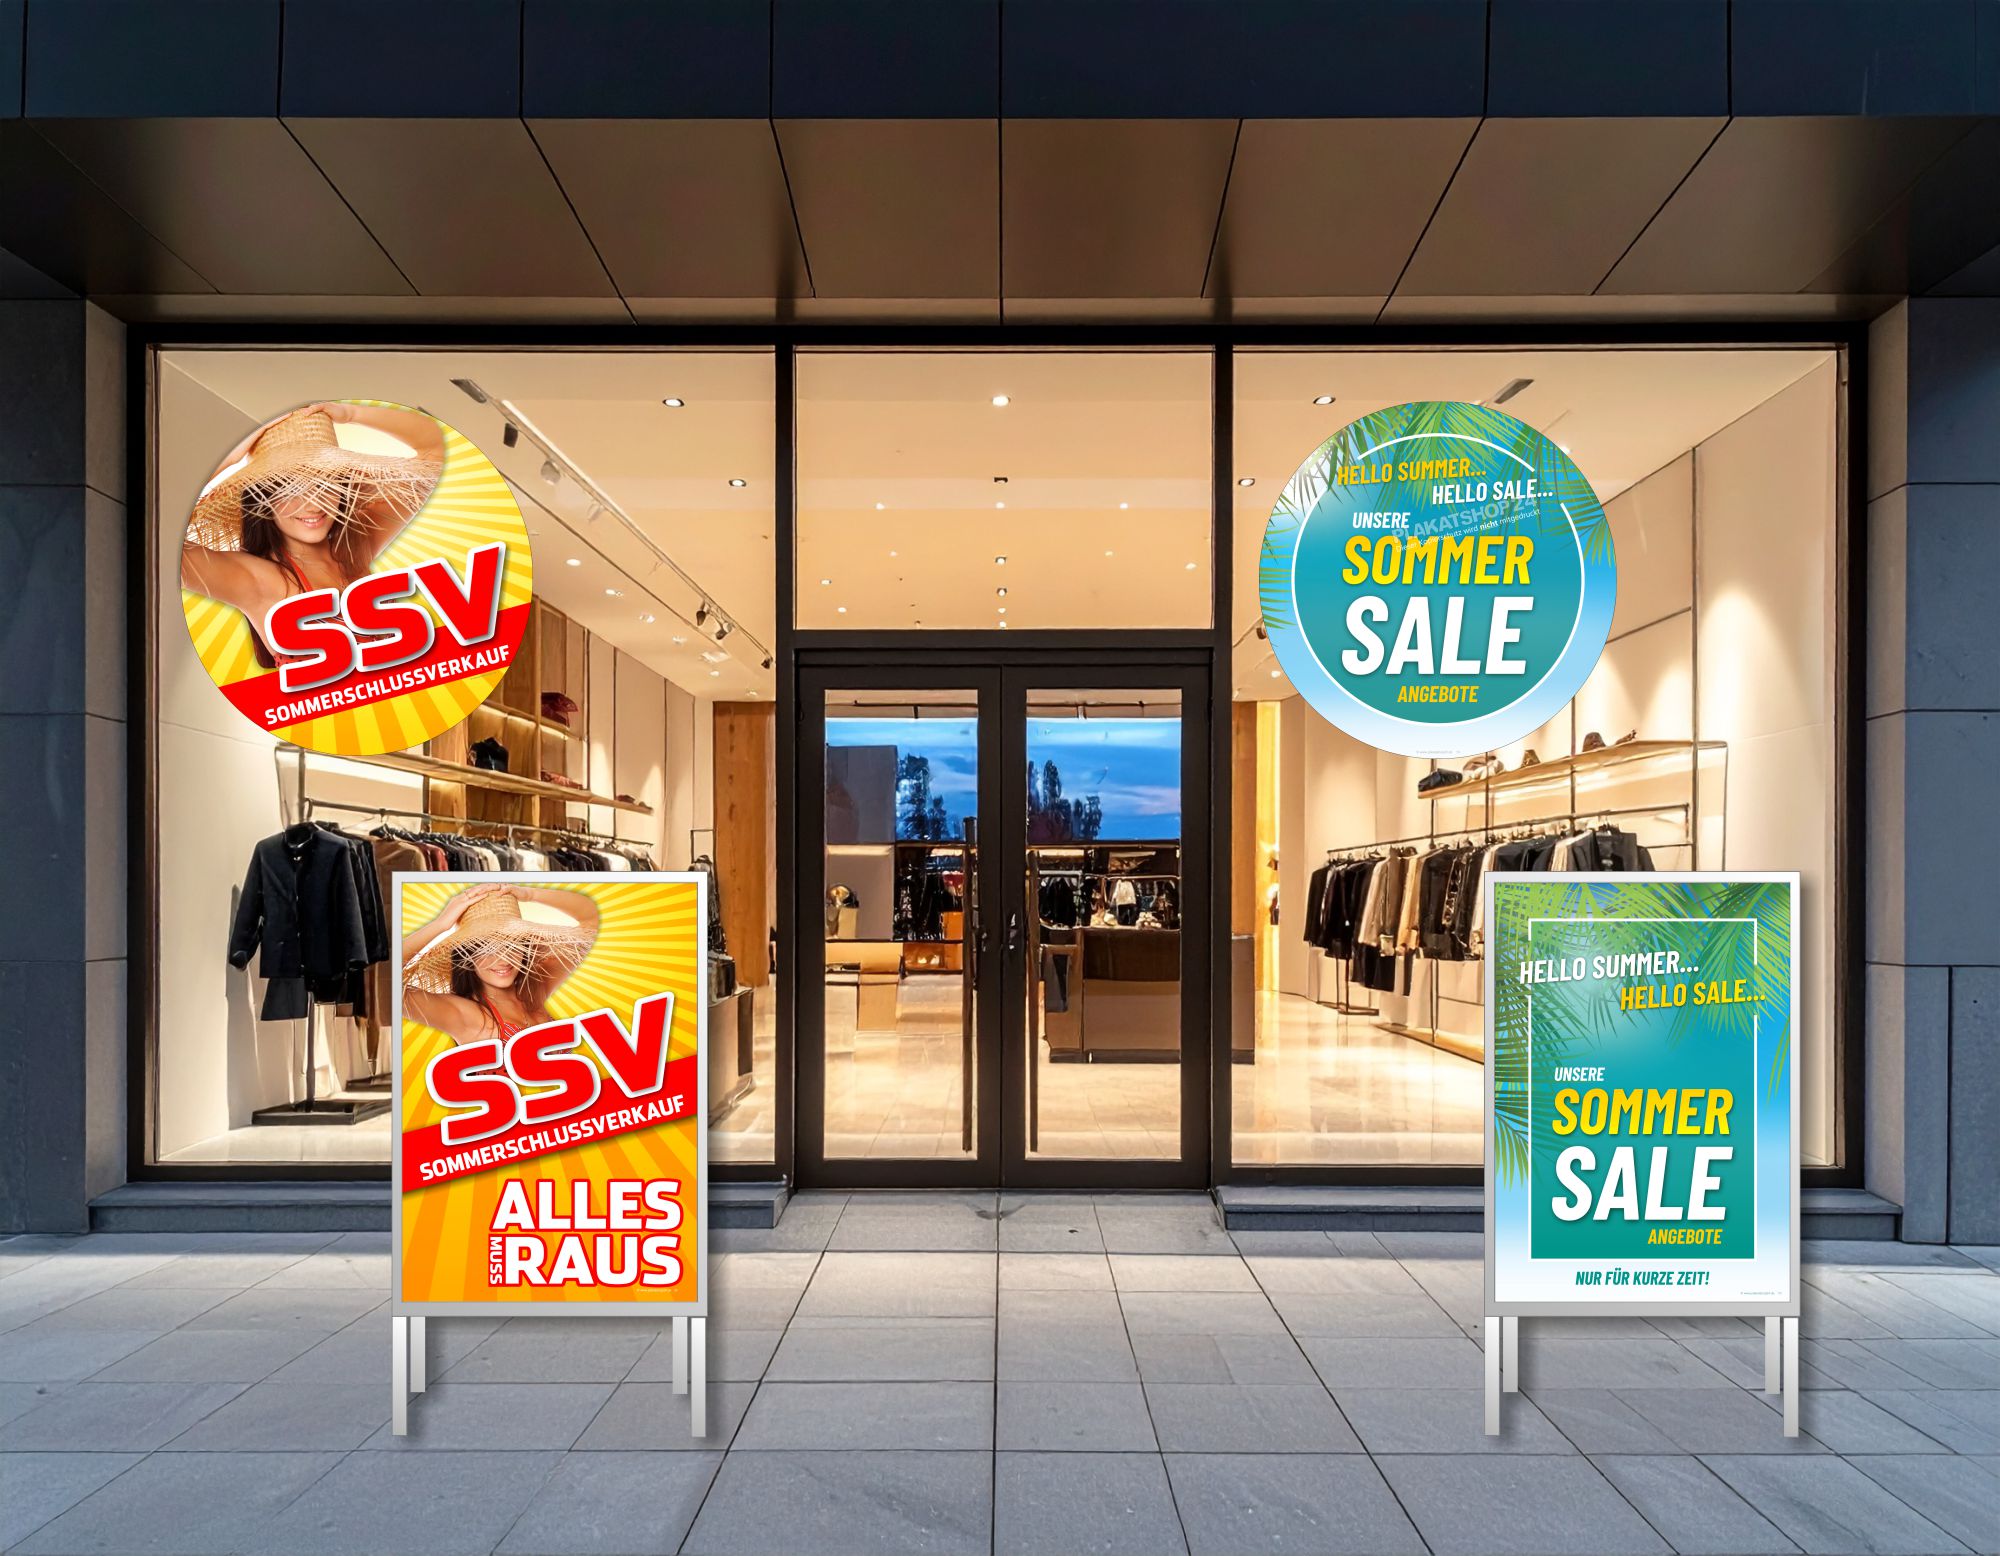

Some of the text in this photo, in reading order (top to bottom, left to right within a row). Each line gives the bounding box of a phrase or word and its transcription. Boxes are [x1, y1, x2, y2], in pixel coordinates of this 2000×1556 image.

[1337, 458, 1487, 486] HELLO SUMMER...
[1432, 478, 1554, 505] HELLO SALE...
[1352, 511, 1411, 529] UNSERE
[1342, 535, 1535, 586] SOMMER
[264, 541, 506, 694] SSV
[1341, 595, 1535, 676] SALE
[264, 644, 511, 726] SOMMERSCHLUSSVERKAUF
[1397, 685, 1480, 703] ANGEBOTE
[1519, 950, 1700, 984] HELLO SUMMER...
[1619, 978, 1767, 1010] HELLO SALE...
[425, 991, 675, 1146] SSV
[1554, 1066, 1606, 1082] UNSERE
[1551, 1087, 1735, 1136] SOMMER
[419, 1094, 685, 1181] SOMMERSCHLUSSVERKAUF
[489, 1178, 684, 1233] ALLES
[1551, 1145, 1735, 1222] SALE
[489, 1235, 503, 1286] MUSS
[502, 1233, 685, 1288] RAUS
[1647, 1228, 1723, 1245] ANGEBOTE
[1575, 1267, 1710, 1286] NUR FÜR KURZE ZEIT!
